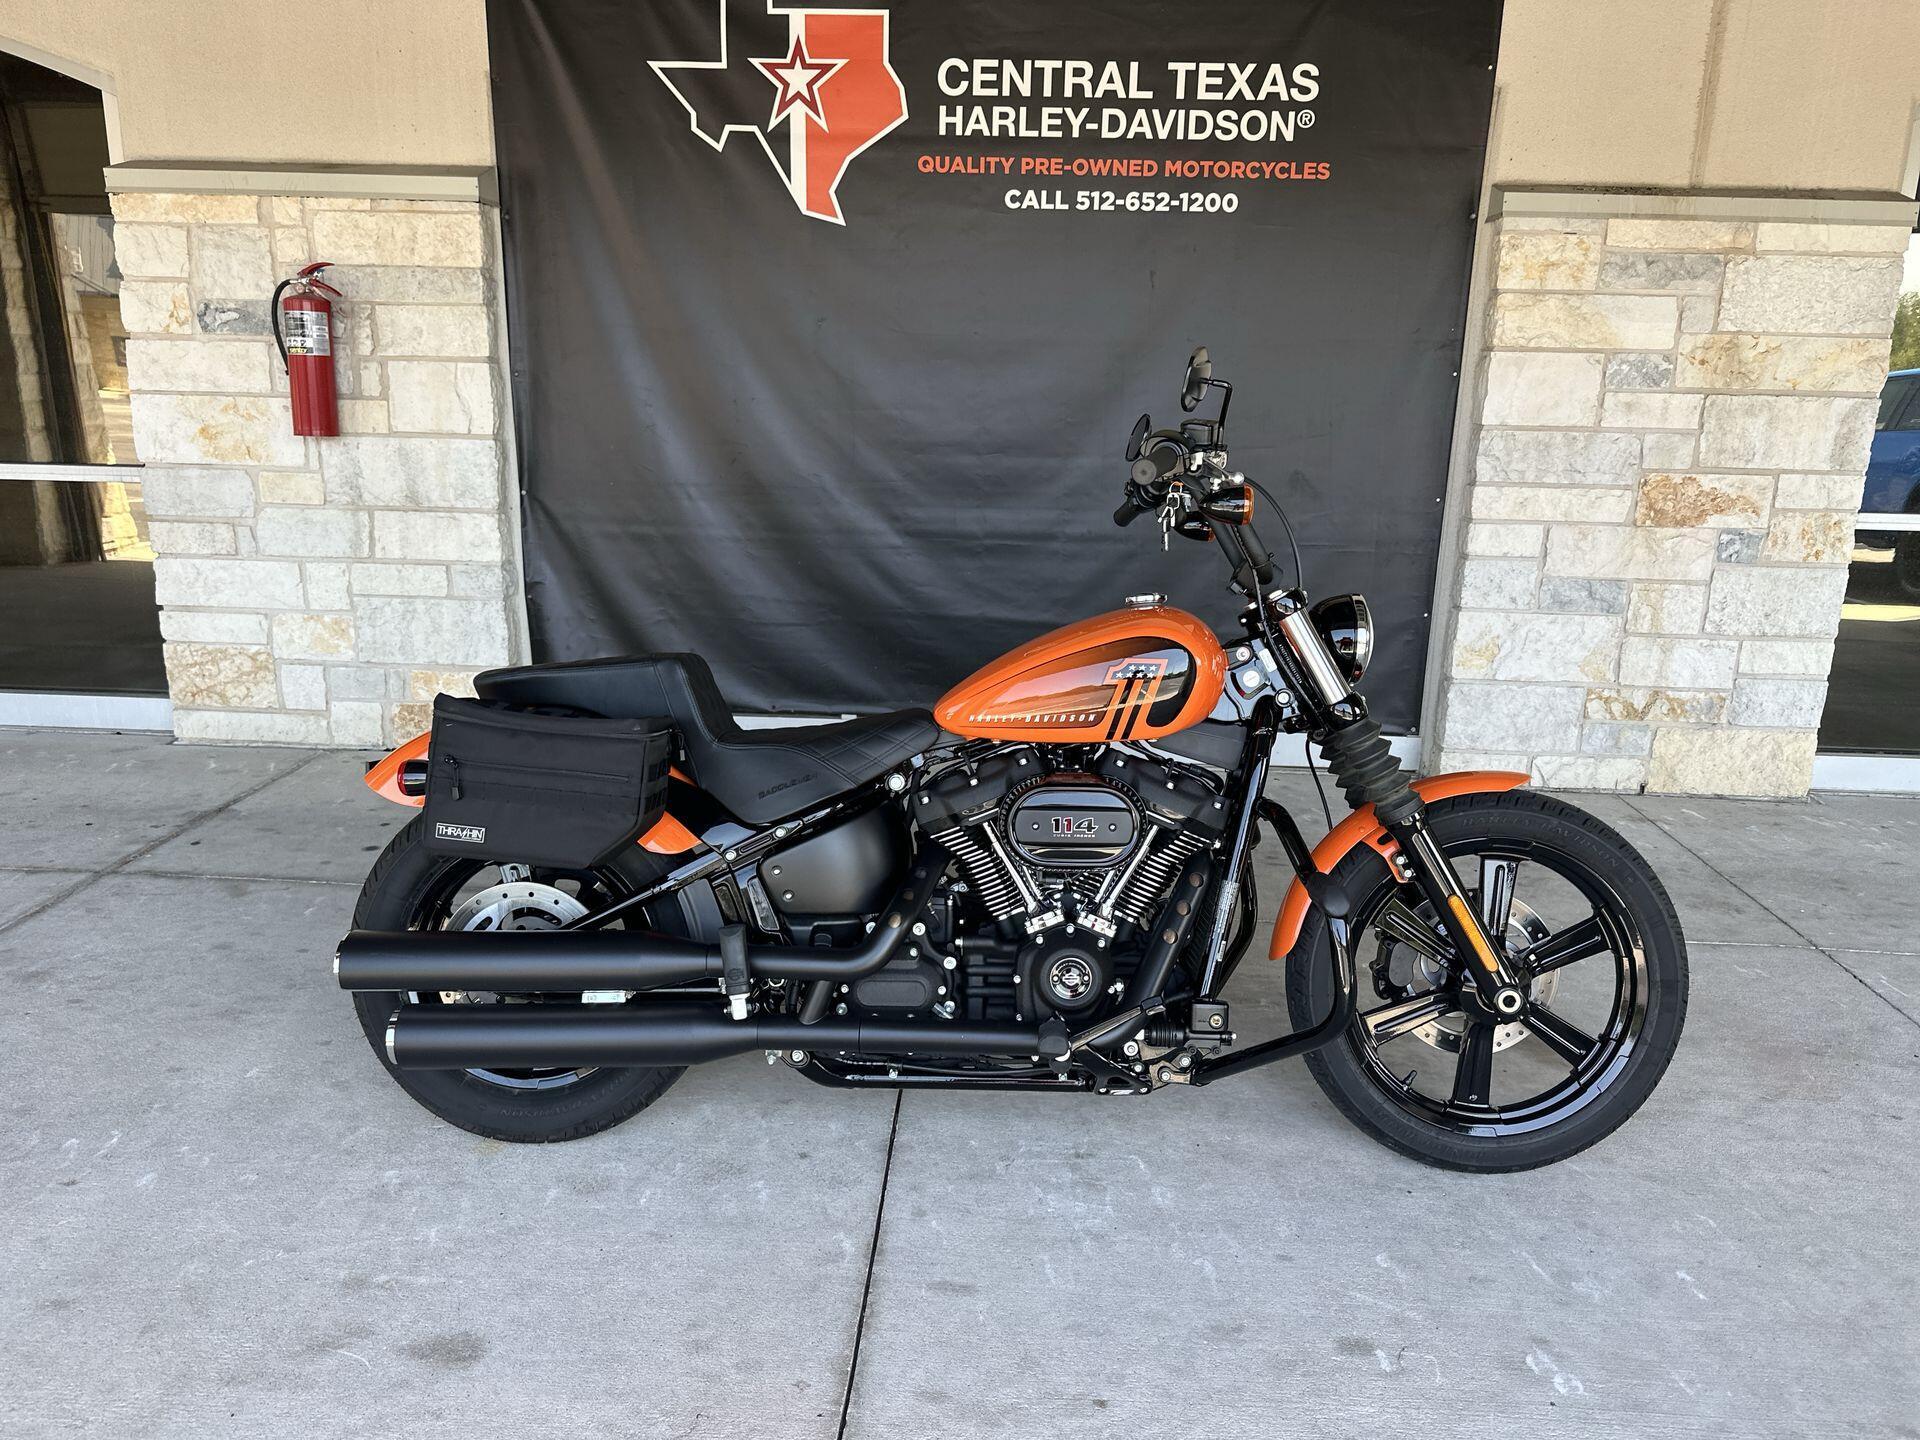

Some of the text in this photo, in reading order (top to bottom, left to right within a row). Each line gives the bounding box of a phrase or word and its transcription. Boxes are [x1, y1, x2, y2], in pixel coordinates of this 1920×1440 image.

[937, 58, 1320, 102] CENTRAL TEXAS
[917, 155, 1331, 180] QUALITY PRE-OWNED MOTORCYCLES
[1004, 189, 1239, 213] CALL 512-652-1200
[1051, 816, 1099, 834] 114
